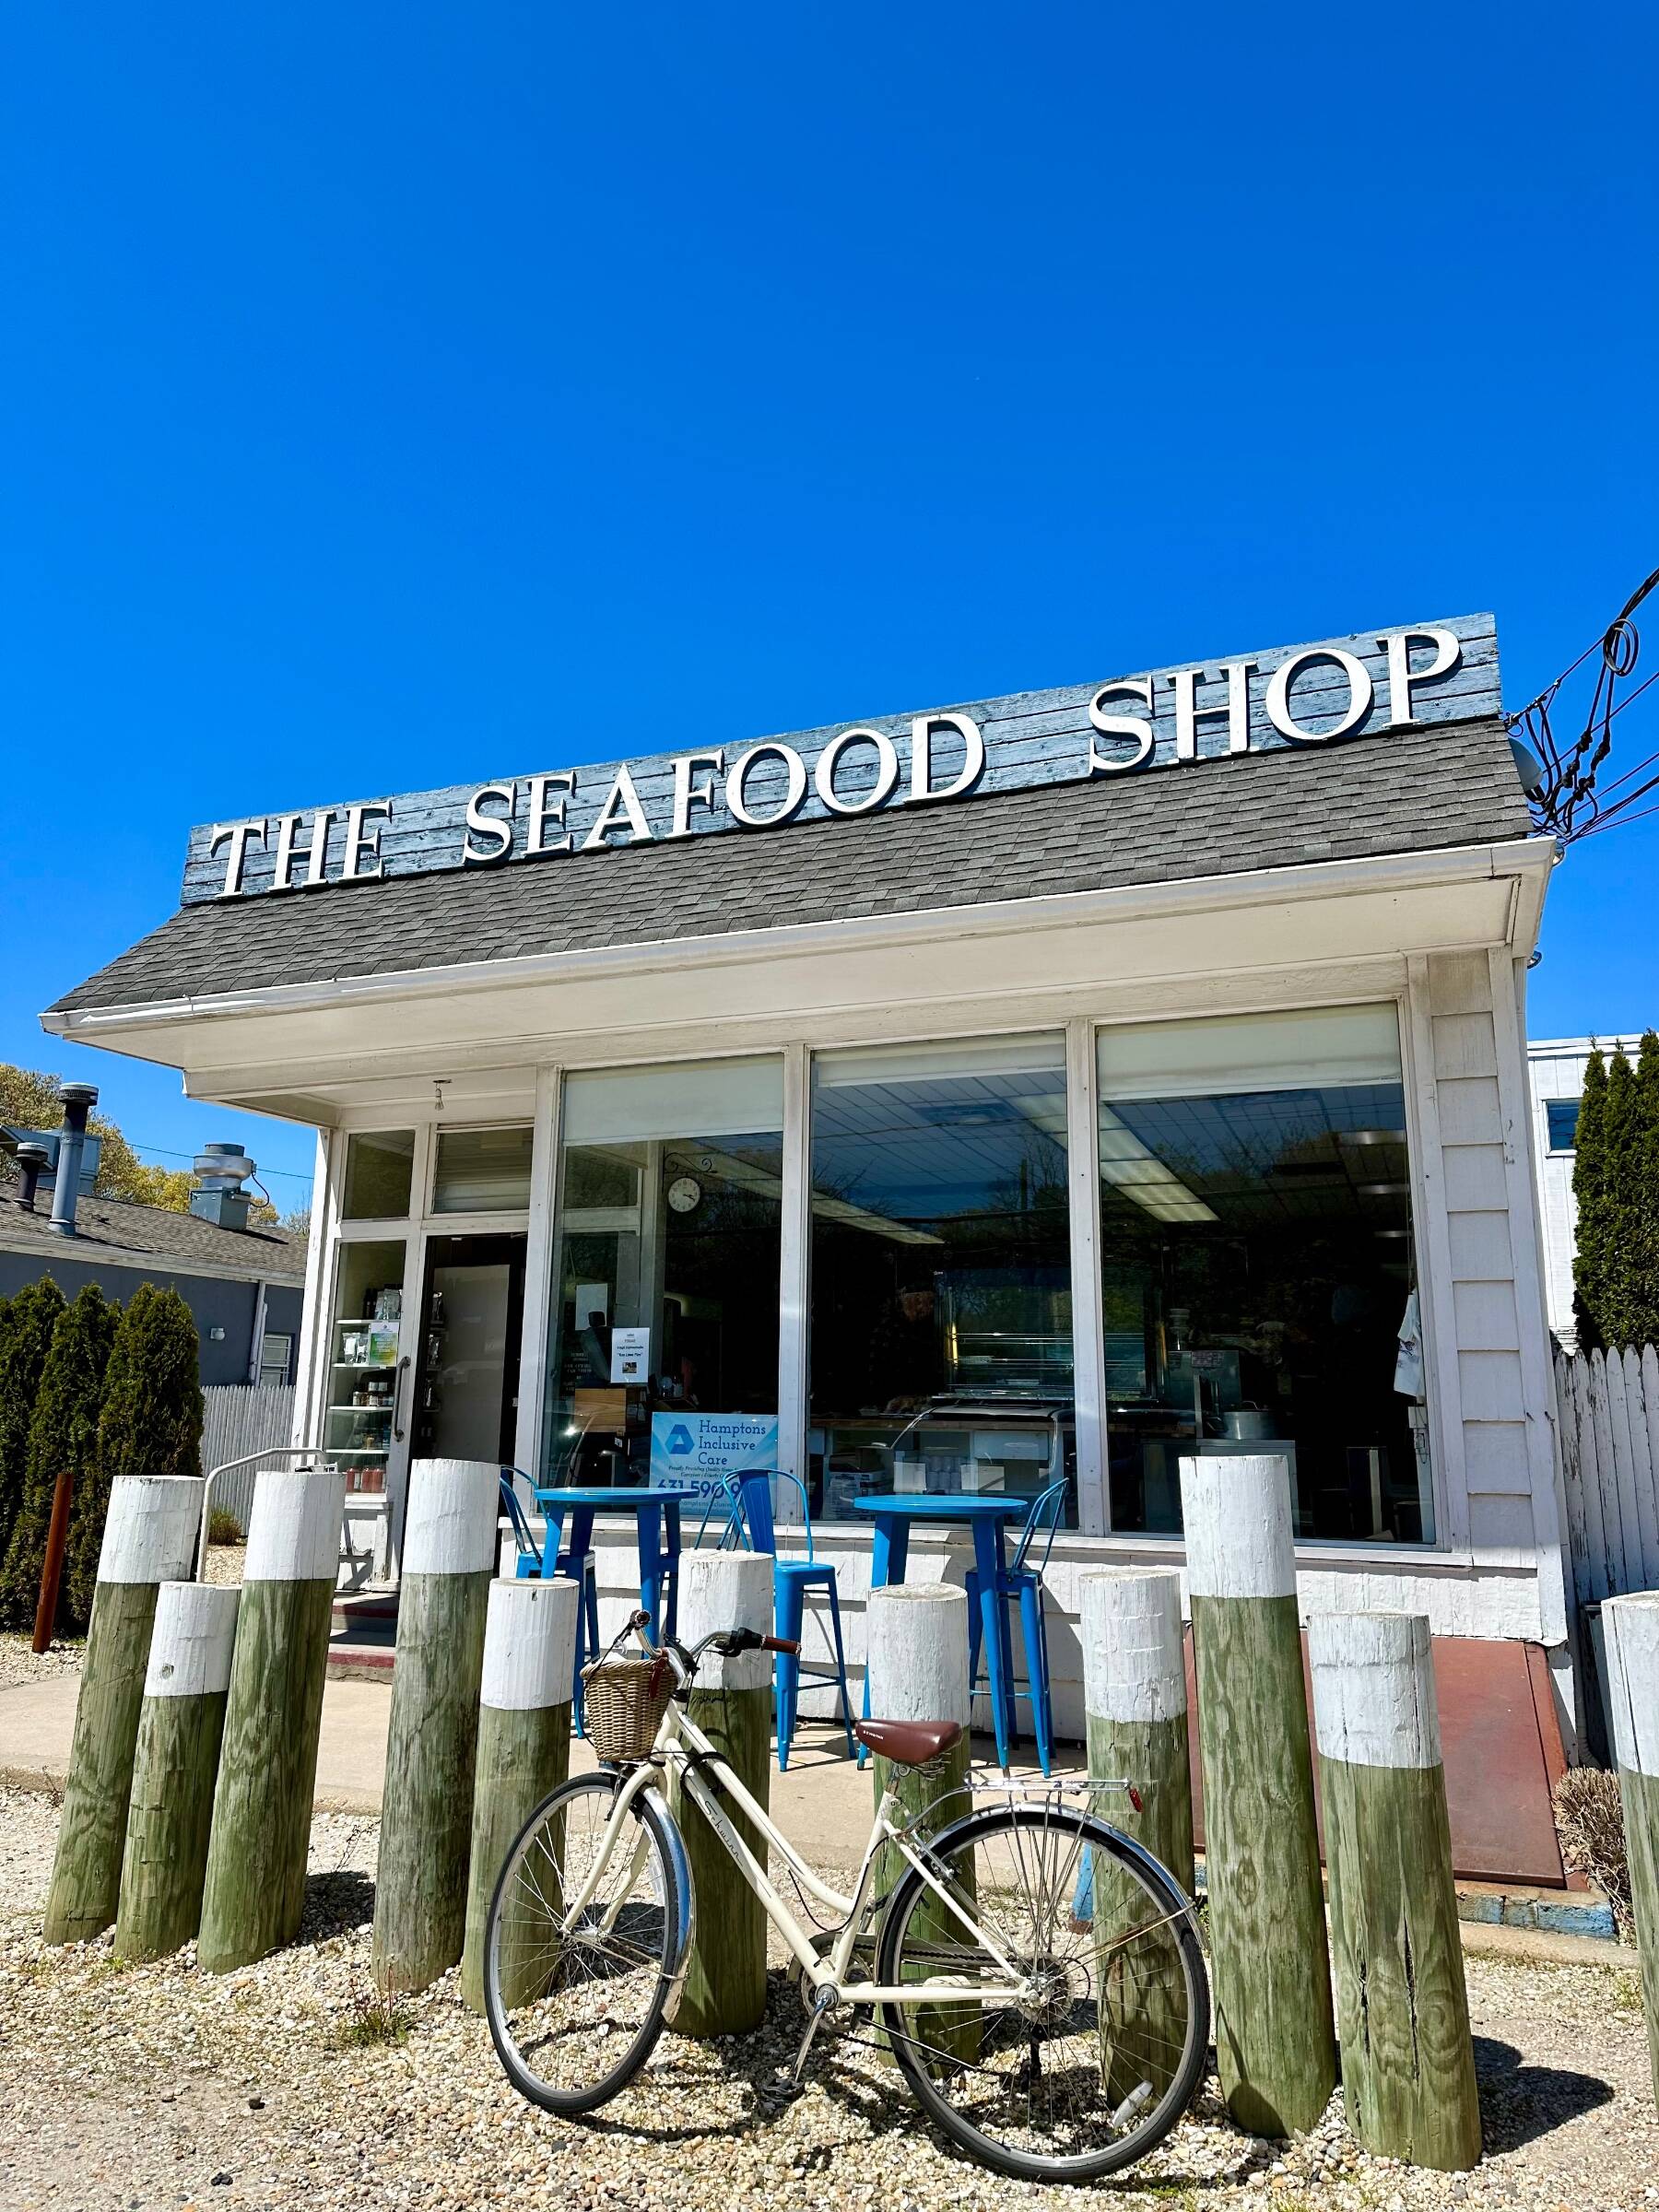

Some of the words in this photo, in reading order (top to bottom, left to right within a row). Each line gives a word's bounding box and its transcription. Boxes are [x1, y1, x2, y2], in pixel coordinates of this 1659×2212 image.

[208, 800, 392, 898] THE
[462, 712, 985, 865] SEAFOOD
[1088, 627, 1460, 774] SHOP
[699, 1420, 766, 1438] Hamptons
[699, 1436, 756, 1451] Inclusive
[698, 1452, 728, 1465] Care
[704, 1800, 744, 1866] Schwinn
